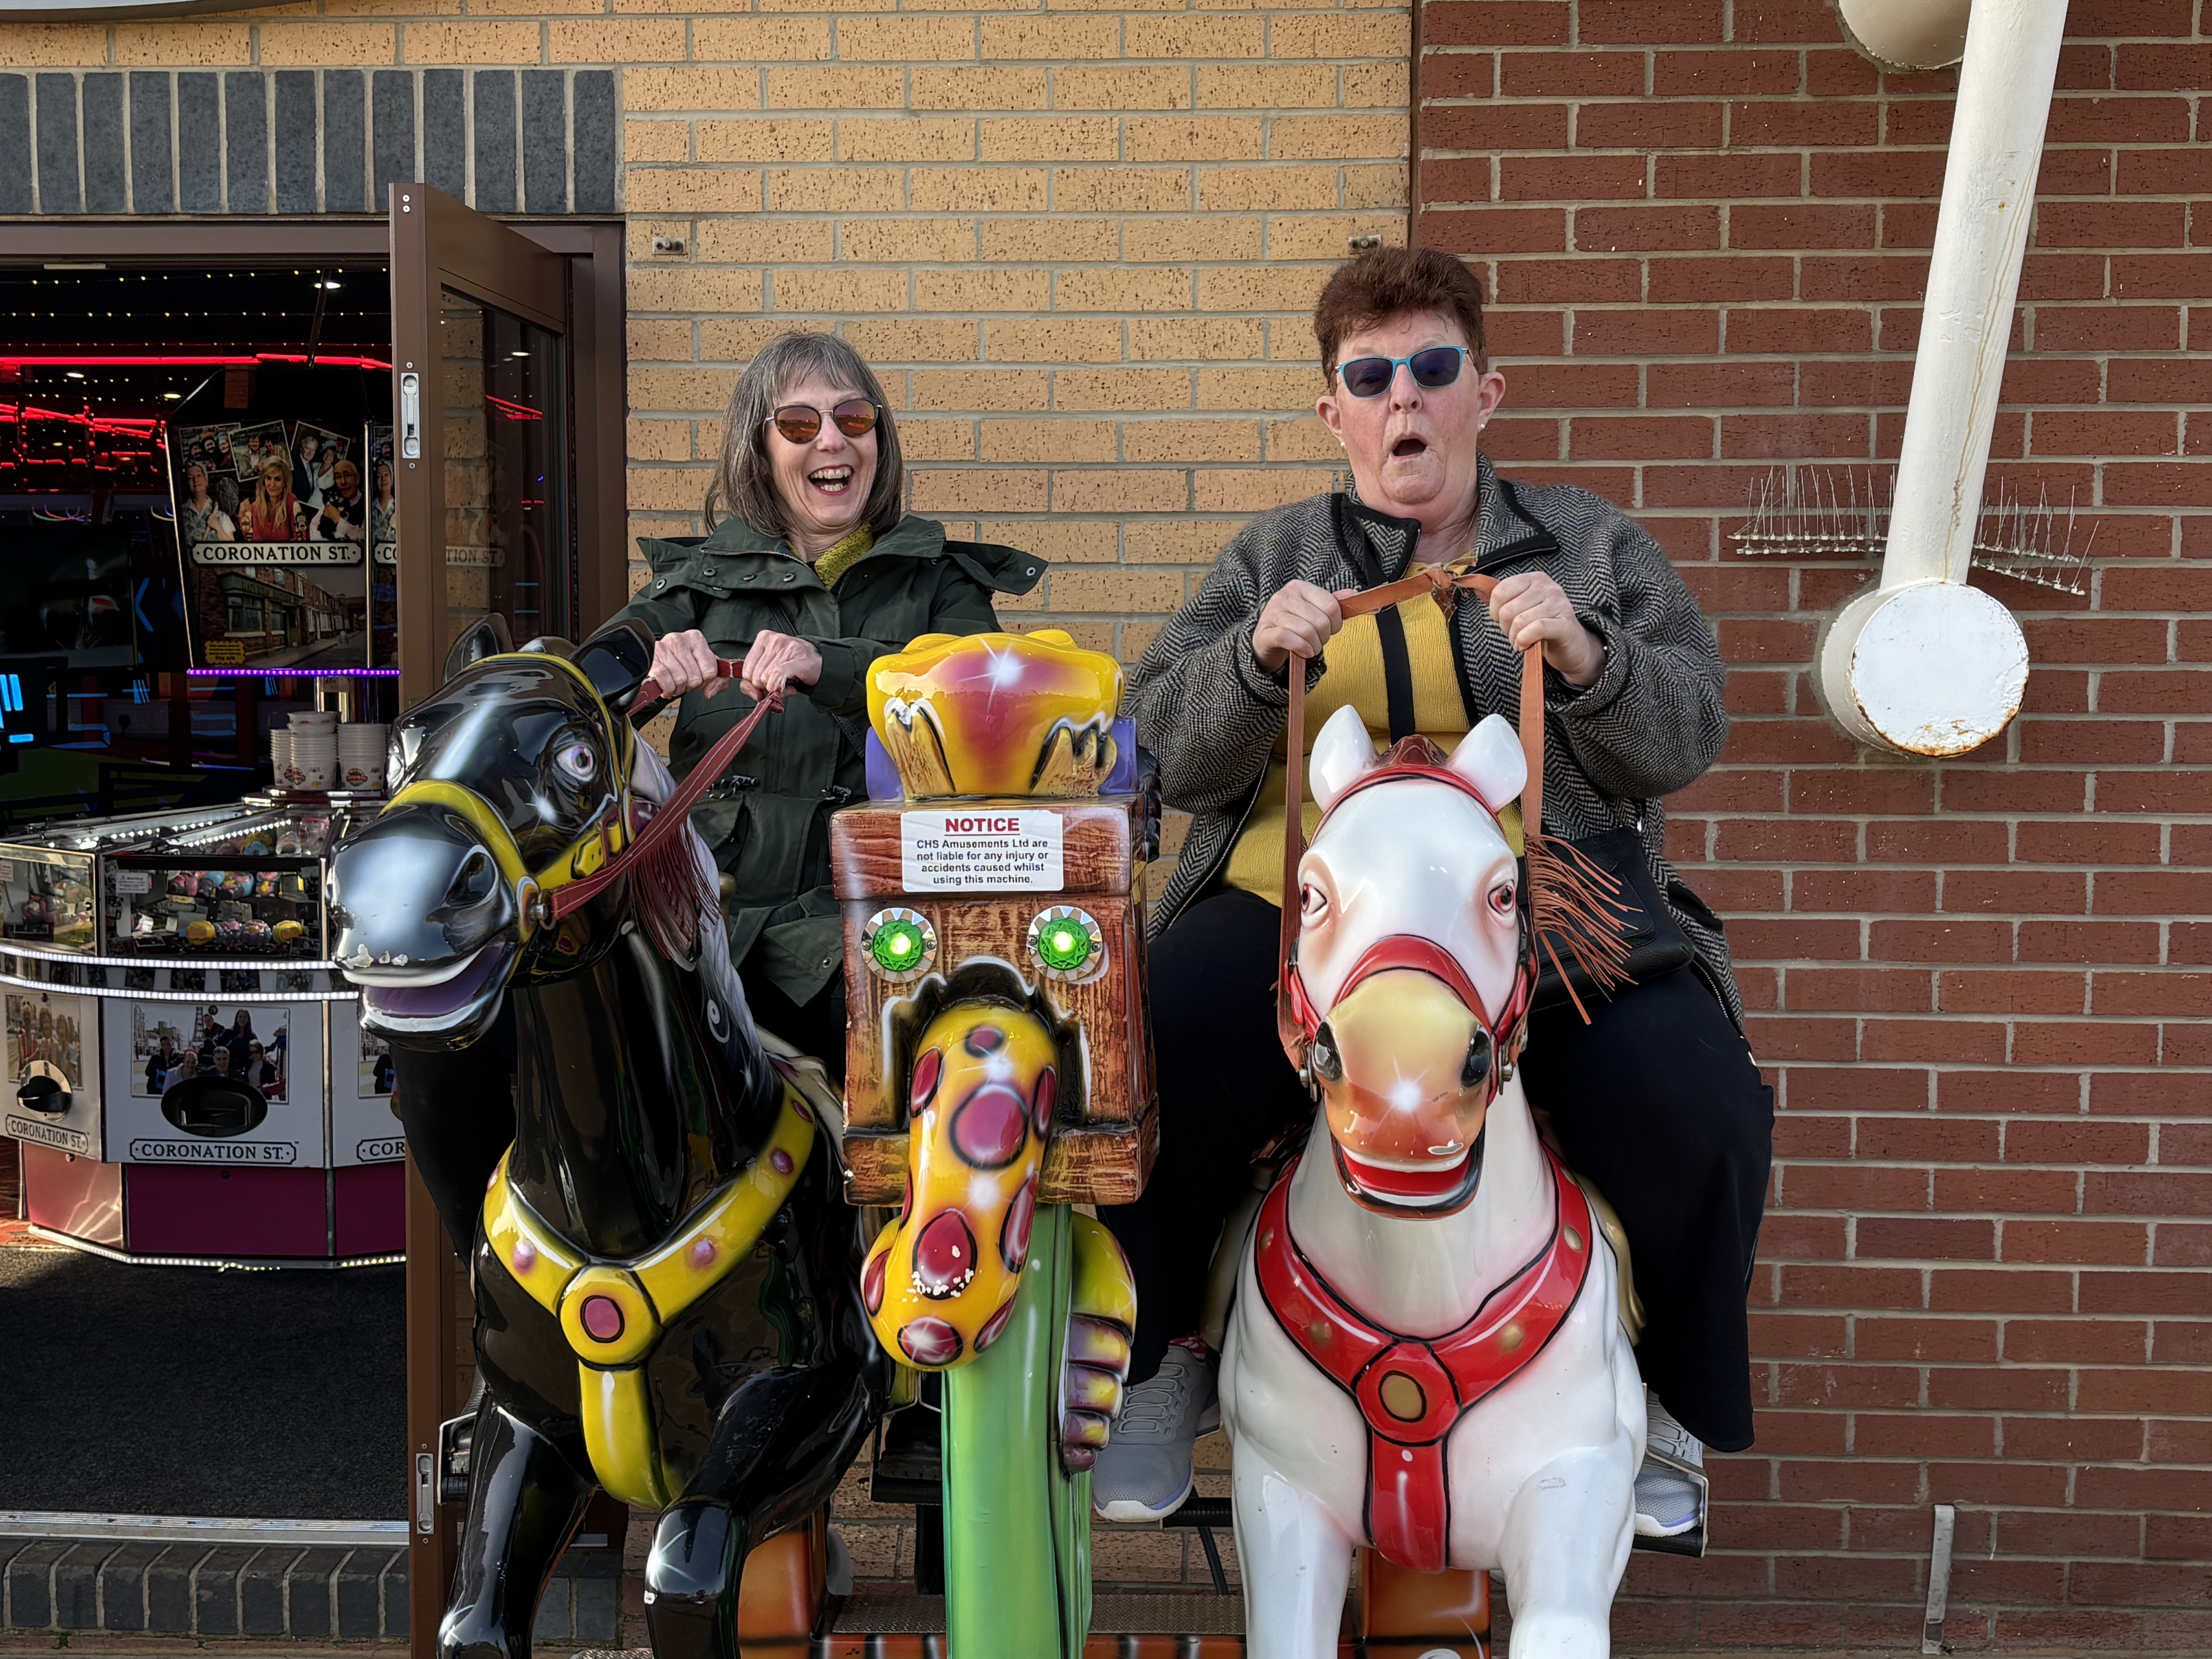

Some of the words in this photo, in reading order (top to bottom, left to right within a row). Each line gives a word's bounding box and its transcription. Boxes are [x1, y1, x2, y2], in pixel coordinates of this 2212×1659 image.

[203, 546, 321, 560] CORONATION
[329, 546, 350, 560] ST.
[945, 817, 1020, 832] NOTICE
[917, 840, 939, 848] CHS
[942, 839, 1009, 848] Amusements
[1013, 839, 1029, 848] Ltd
[937, 852, 963, 860] liable
[967, 852, 981, 860] for
[984, 852, 1002, 862] any
[1006, 851, 1034, 862] injury
[922, 864, 970, 872] accidents
[974, 863, 1010, 871] caused
[1014, 863, 1044, 871] whilst
[933, 876, 962, 886] using
[965, 875, 983, 883] this
[987, 875, 1033, 884] machine.
[12, 1120, 68, 1145] CORONATION
[142, 1144, 256, 1159] CORONATION
[263, 1147, 284, 1160] ST.
